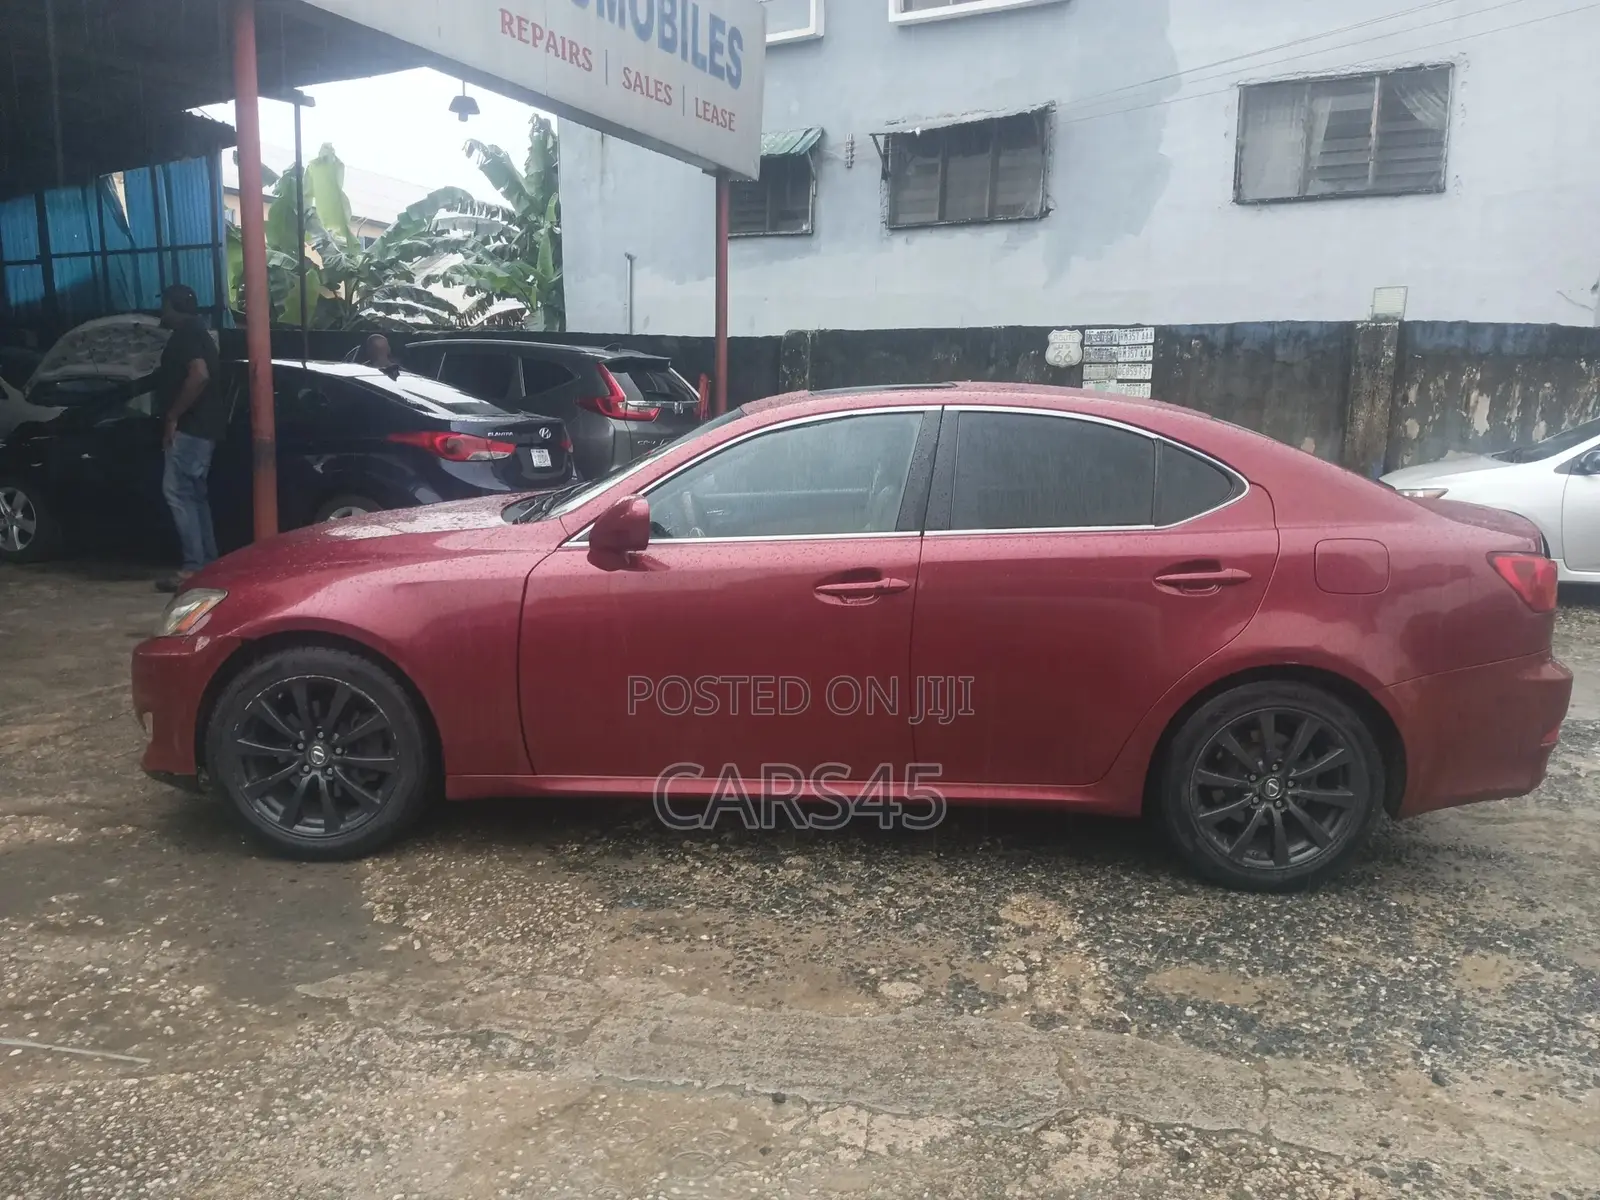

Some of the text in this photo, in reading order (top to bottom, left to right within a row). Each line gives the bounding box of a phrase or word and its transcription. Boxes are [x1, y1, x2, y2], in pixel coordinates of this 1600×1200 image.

[499, 8, 736, 132] REPAIRS SALES LEASE
[569, 0, 744, 91] OBILES
[1053, 333, 1077, 341] ROUTE
[1053, 350, 1073, 363] 66
